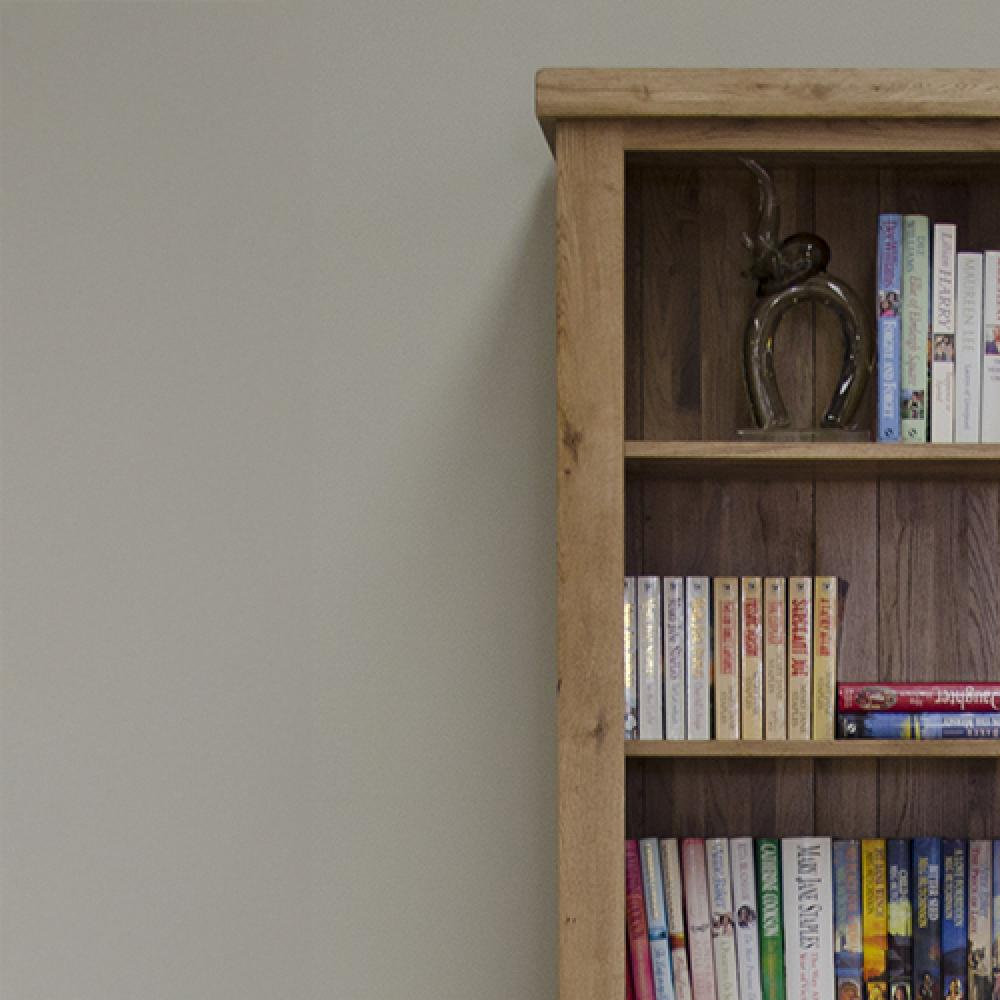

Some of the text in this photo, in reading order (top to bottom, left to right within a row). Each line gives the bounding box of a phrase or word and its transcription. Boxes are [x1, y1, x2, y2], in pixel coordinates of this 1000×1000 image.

[938, 269, 951, 330] HARRY
[962, 260, 974, 352] MAUREEN LEE
[761, 845, 777, 891] CATHERINE
[795, 846, 821, 949] MARY JANE STAPLES
[762, 895, 778, 937] COOKSON
